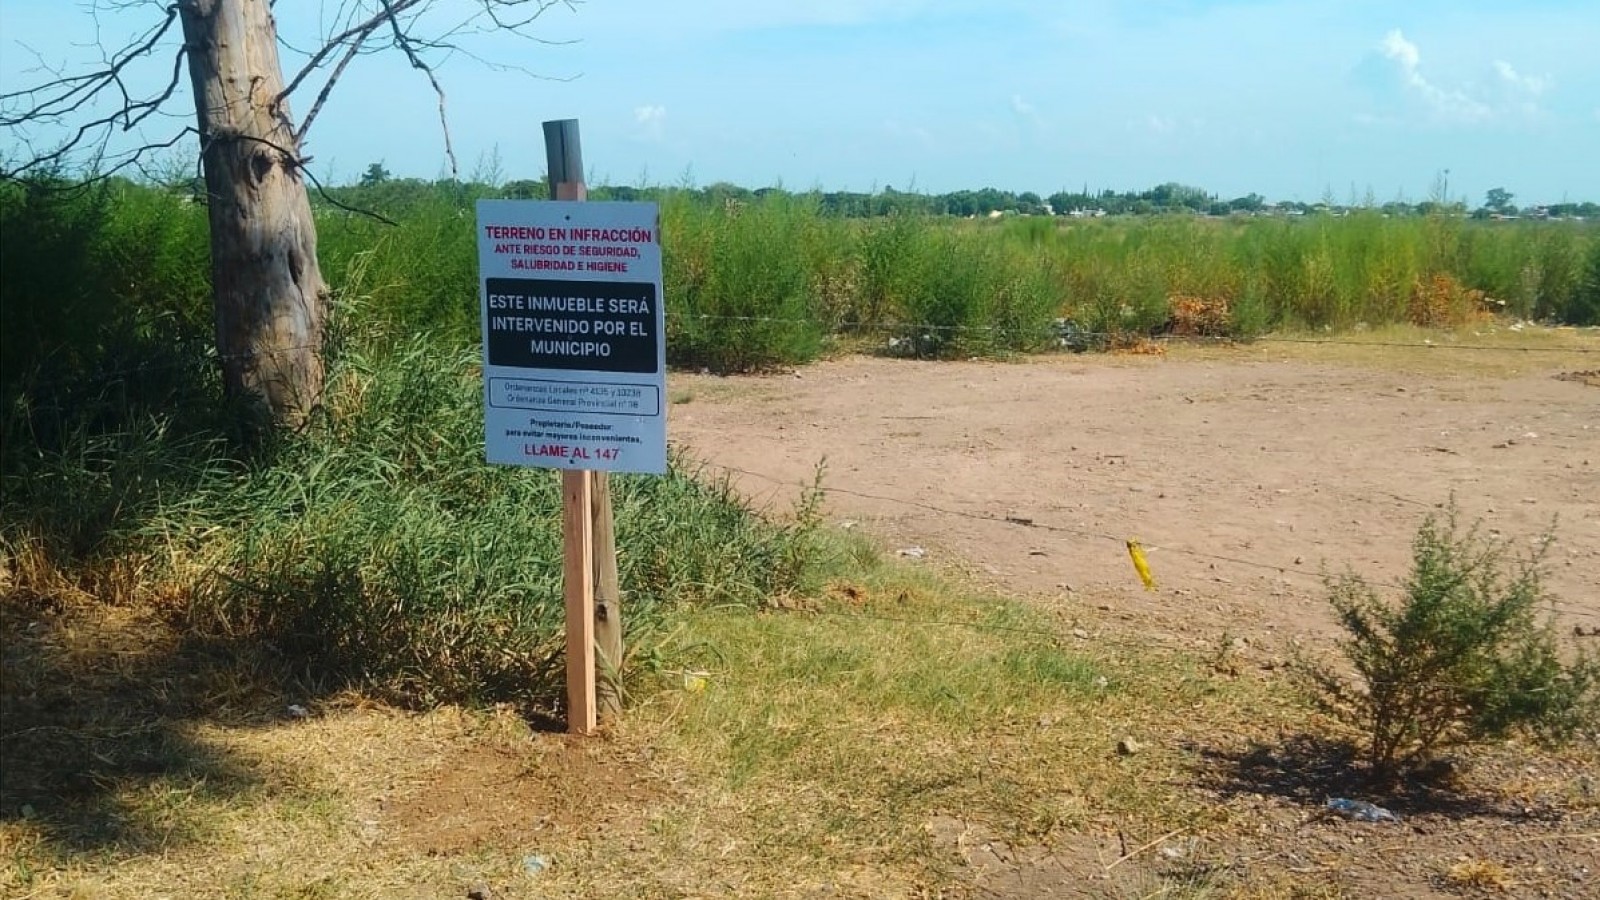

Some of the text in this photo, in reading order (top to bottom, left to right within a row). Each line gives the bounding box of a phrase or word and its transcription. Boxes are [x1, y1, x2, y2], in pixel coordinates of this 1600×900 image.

[485, 226, 651, 242] TERRENO EN INFRACCIÓN
[495, 244, 641, 259] ANTE RIESGO DE SEGURIDAD,
[511, 259, 628, 272] SALUBRIDAD E HIGIENE
[489, 295, 650, 314] ESTE INMUEBLE SERÁ
[493, 316, 648, 336] INTERVENIDO POR EL
[531, 340, 611, 357] MUNICIPIO
[547, 396, 577, 405] General
[506, 429, 521, 438] para
[523, 430, 544, 438] evitar
[545, 431, 578, 441] mayores
[524, 444, 620, 461] LLAME AL 147
